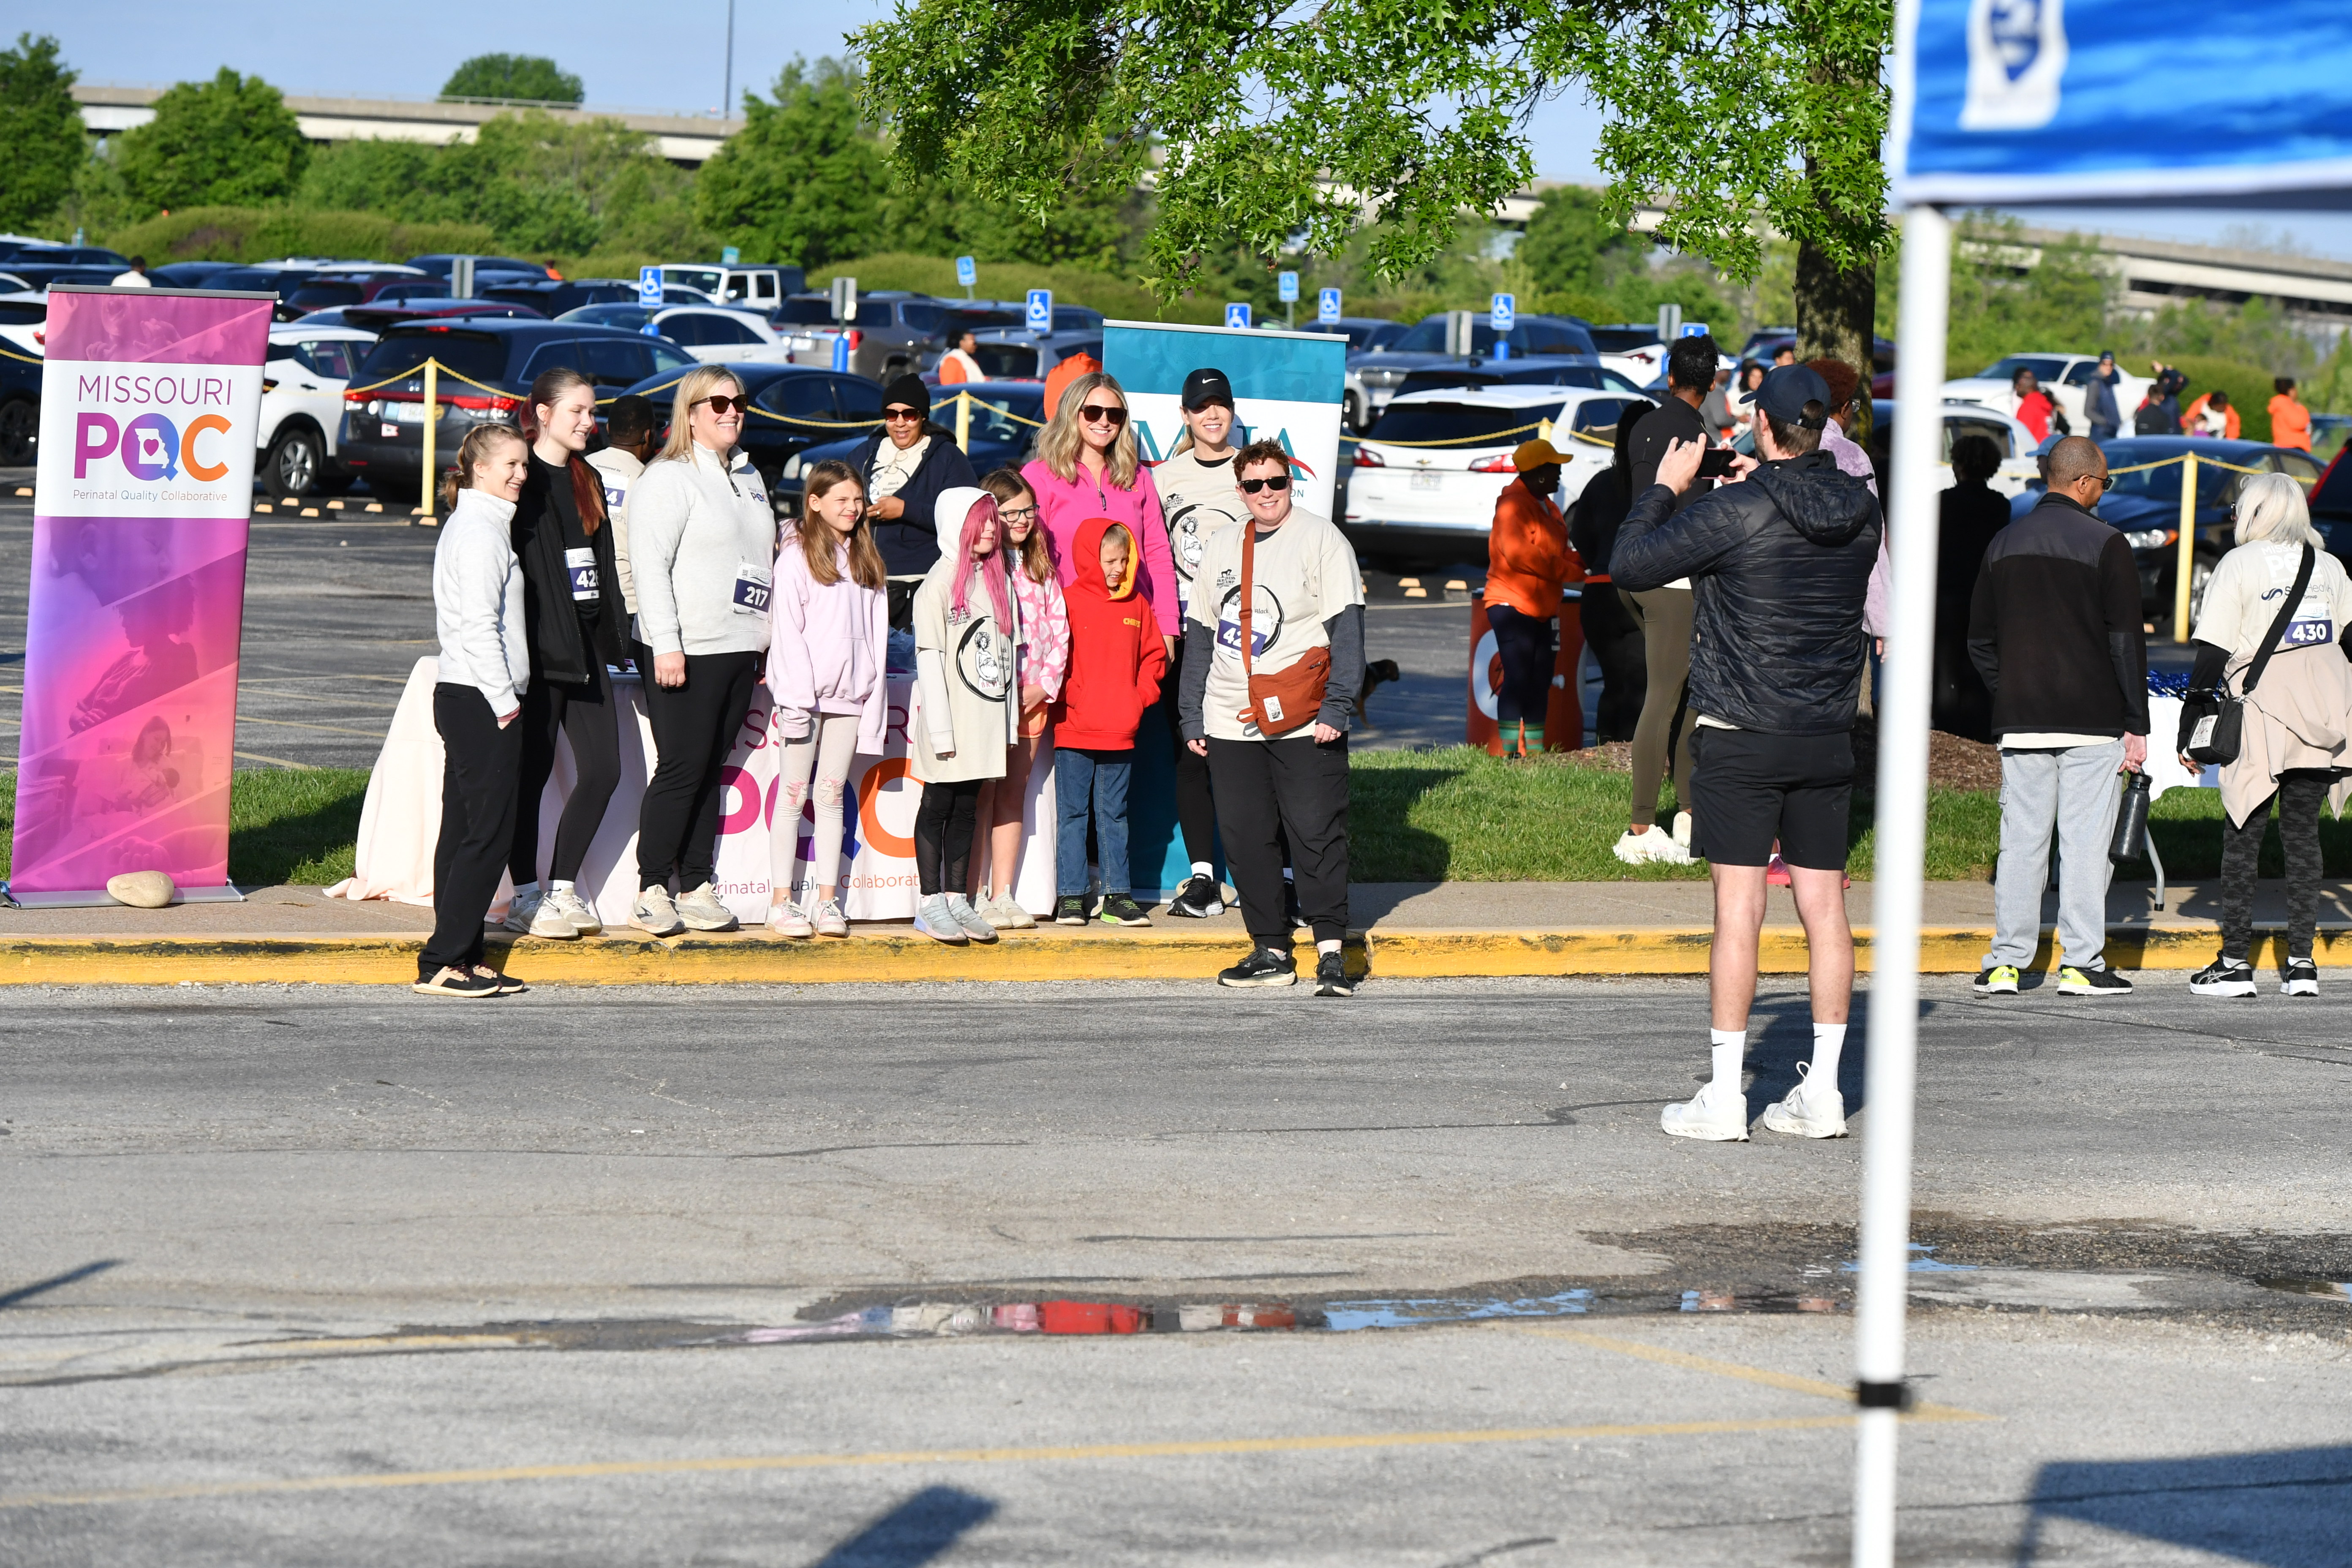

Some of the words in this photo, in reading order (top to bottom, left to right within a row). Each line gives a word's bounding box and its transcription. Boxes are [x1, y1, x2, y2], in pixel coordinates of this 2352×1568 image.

[79, 375, 231, 405] MISSOURI
[74, 412, 232, 482] PQC
[73, 490, 117, 499] Perinatal
[121, 490, 158, 502] Quality
[161, 491, 227, 501] Collaborative
[744, 586, 768, 607] 217
[2292, 623, 2327, 641] 430
[717, 879, 770, 895] rinatal
[840, 873, 919, 889] Collaborat
[1252, 967, 1277, 976] ALTRA
